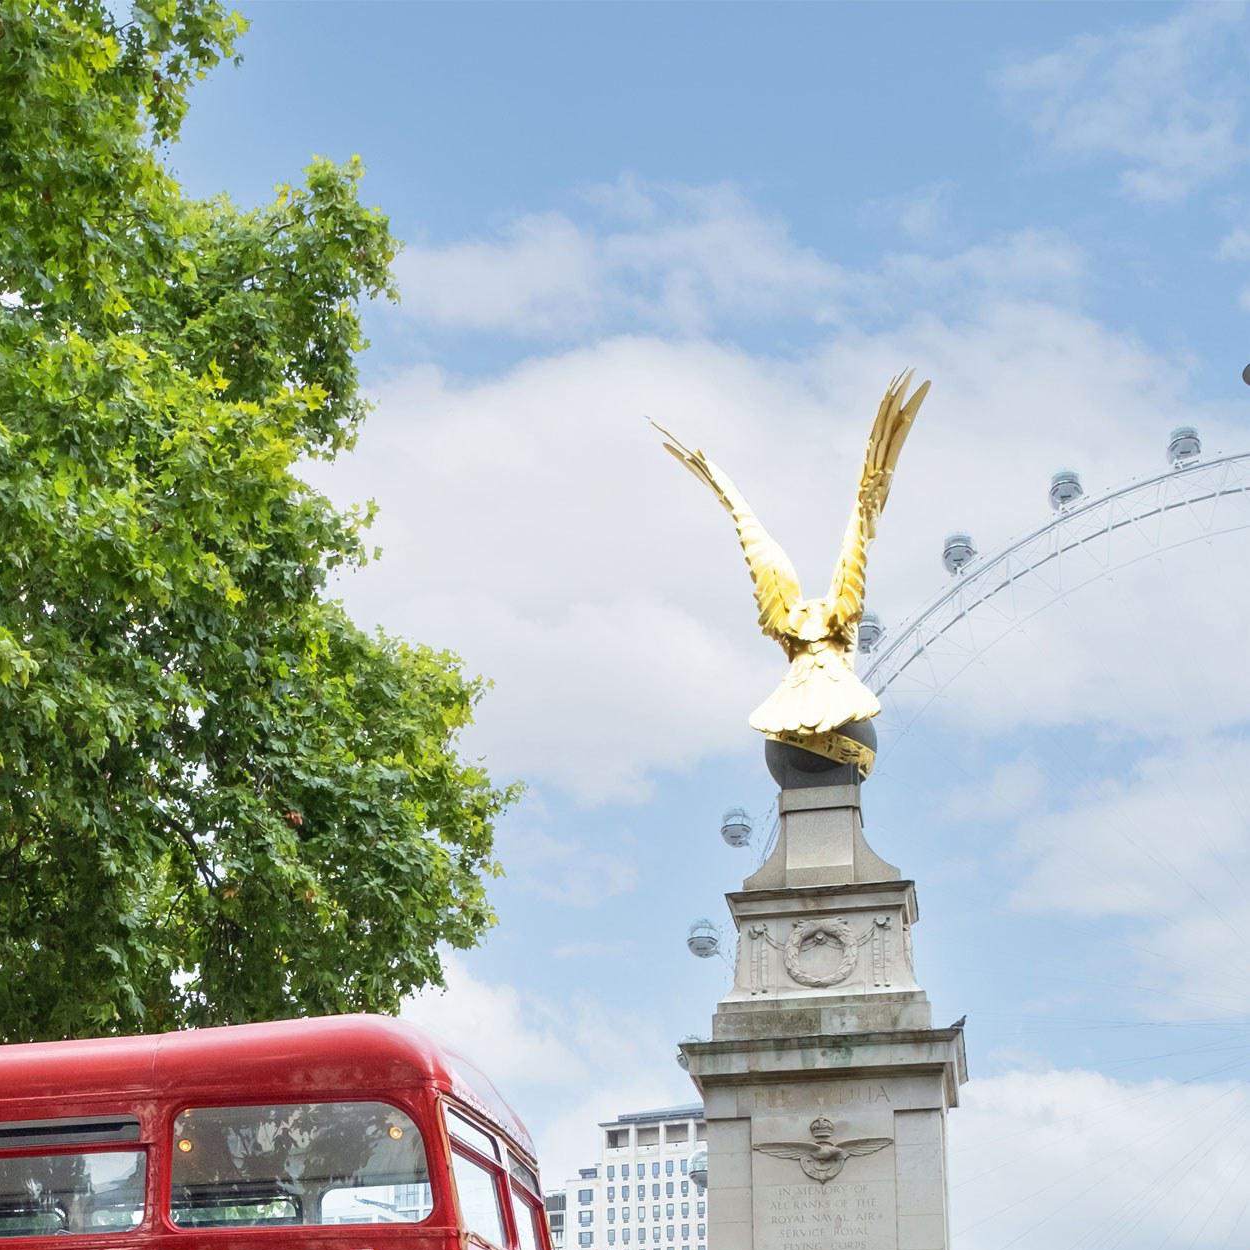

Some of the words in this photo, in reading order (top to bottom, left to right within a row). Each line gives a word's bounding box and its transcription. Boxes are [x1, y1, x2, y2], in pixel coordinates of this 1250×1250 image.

[779, 1187, 791, 1196] IN
[853, 1184, 869, 1193] OF
[856, 1198, 878, 1208] THE
[771, 1215, 806, 1225] ROYAL
[855, 1212, 875, 1222] AIR
